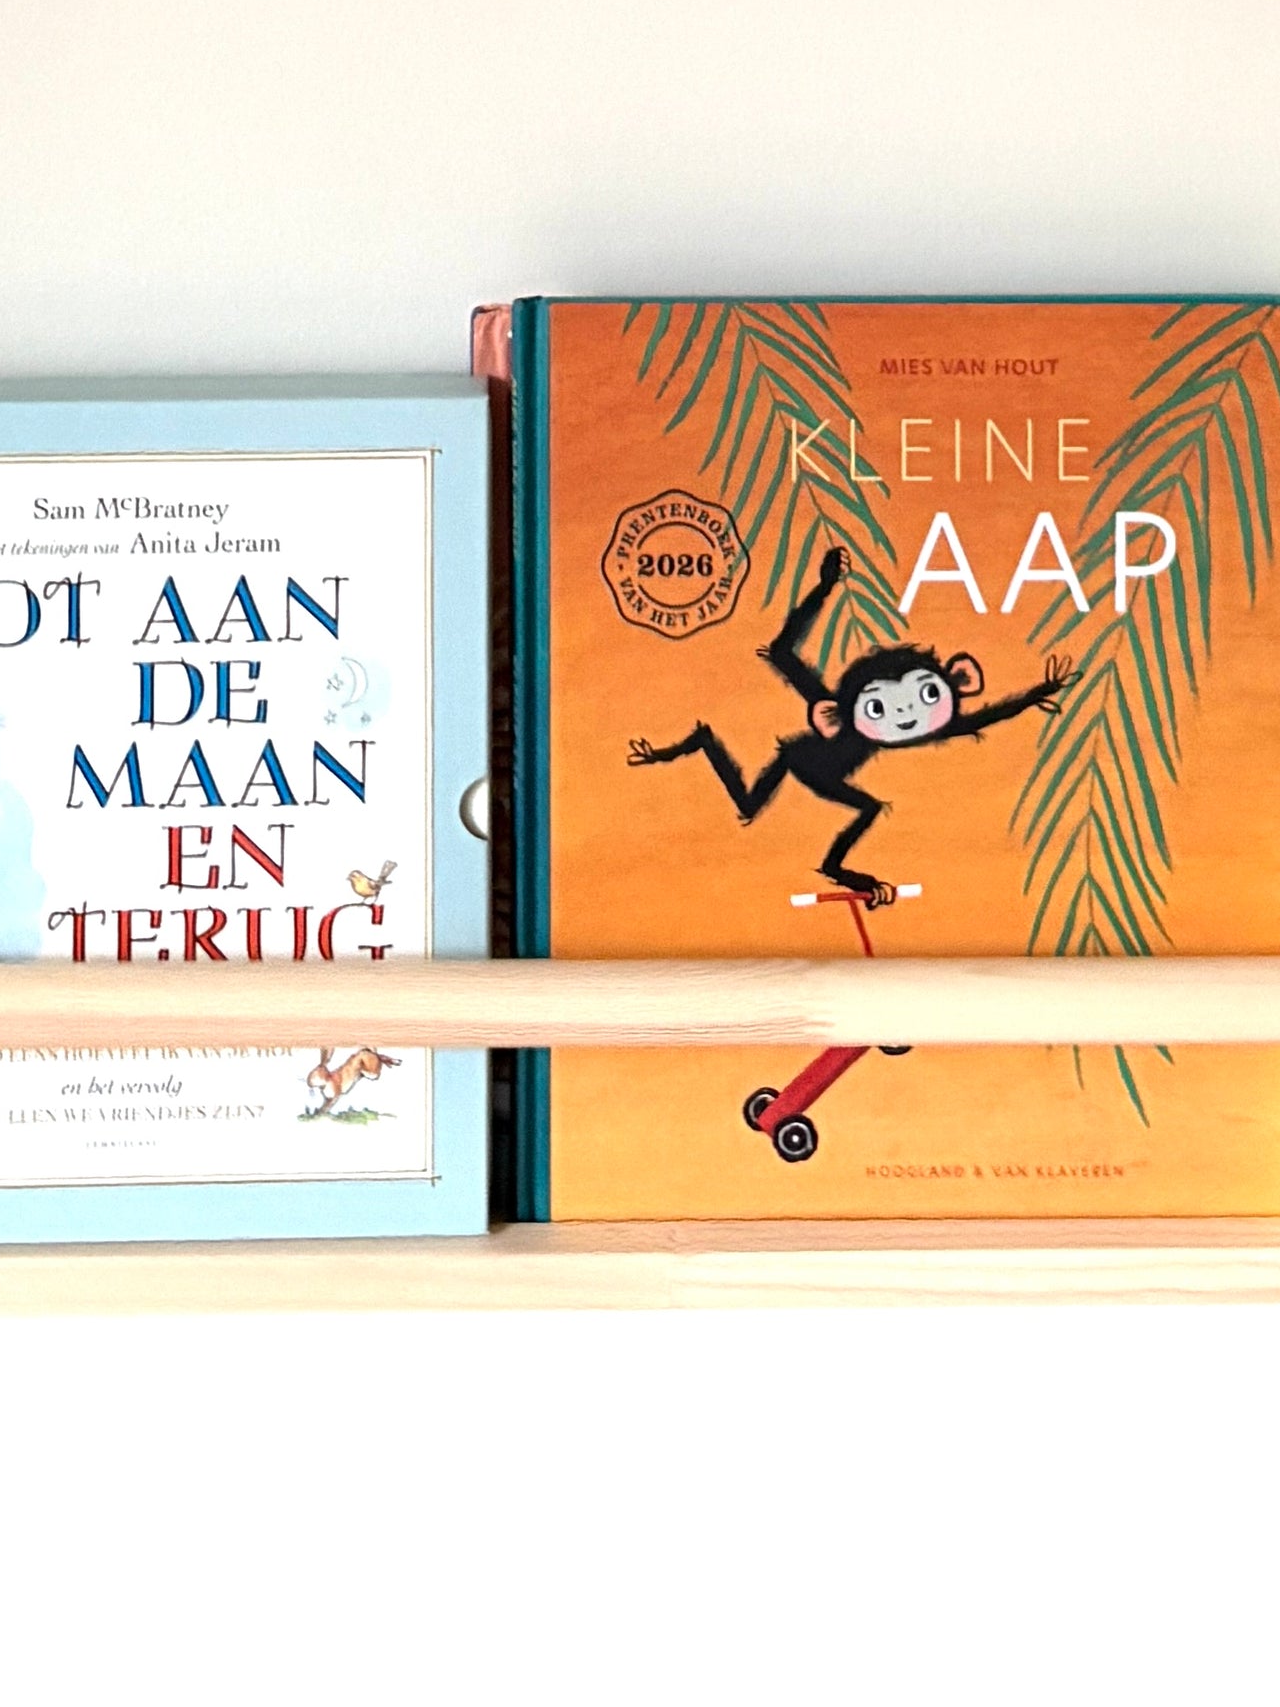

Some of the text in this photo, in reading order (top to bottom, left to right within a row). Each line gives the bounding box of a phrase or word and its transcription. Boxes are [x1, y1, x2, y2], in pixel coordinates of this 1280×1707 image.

[879, 358, 1060, 378] MIES VAN HOUT
[790, 419, 1091, 482] KLEINE
[33, 498, 85, 520] Sam
[617, 503, 736, 559] PRENTENBOEK
[10, 539, 89, 559] tekeningen
[130, 532, 197, 554] Anita
[204, 531, 281, 554] Jeram
[637, 553, 714, 577] 2026
[899, 512, 1177, 615] AAP
[132, 574, 350, 646] AAN
[620, 577, 732, 626] VAN HET JAAR
[131, 658, 269, 729] DE
[66, 739, 376, 810] MAAN
[160, 823, 295, 893] EN
[48, 902, 394, 961] TERUG
[991, 1164, 1029, 1178] VAN
